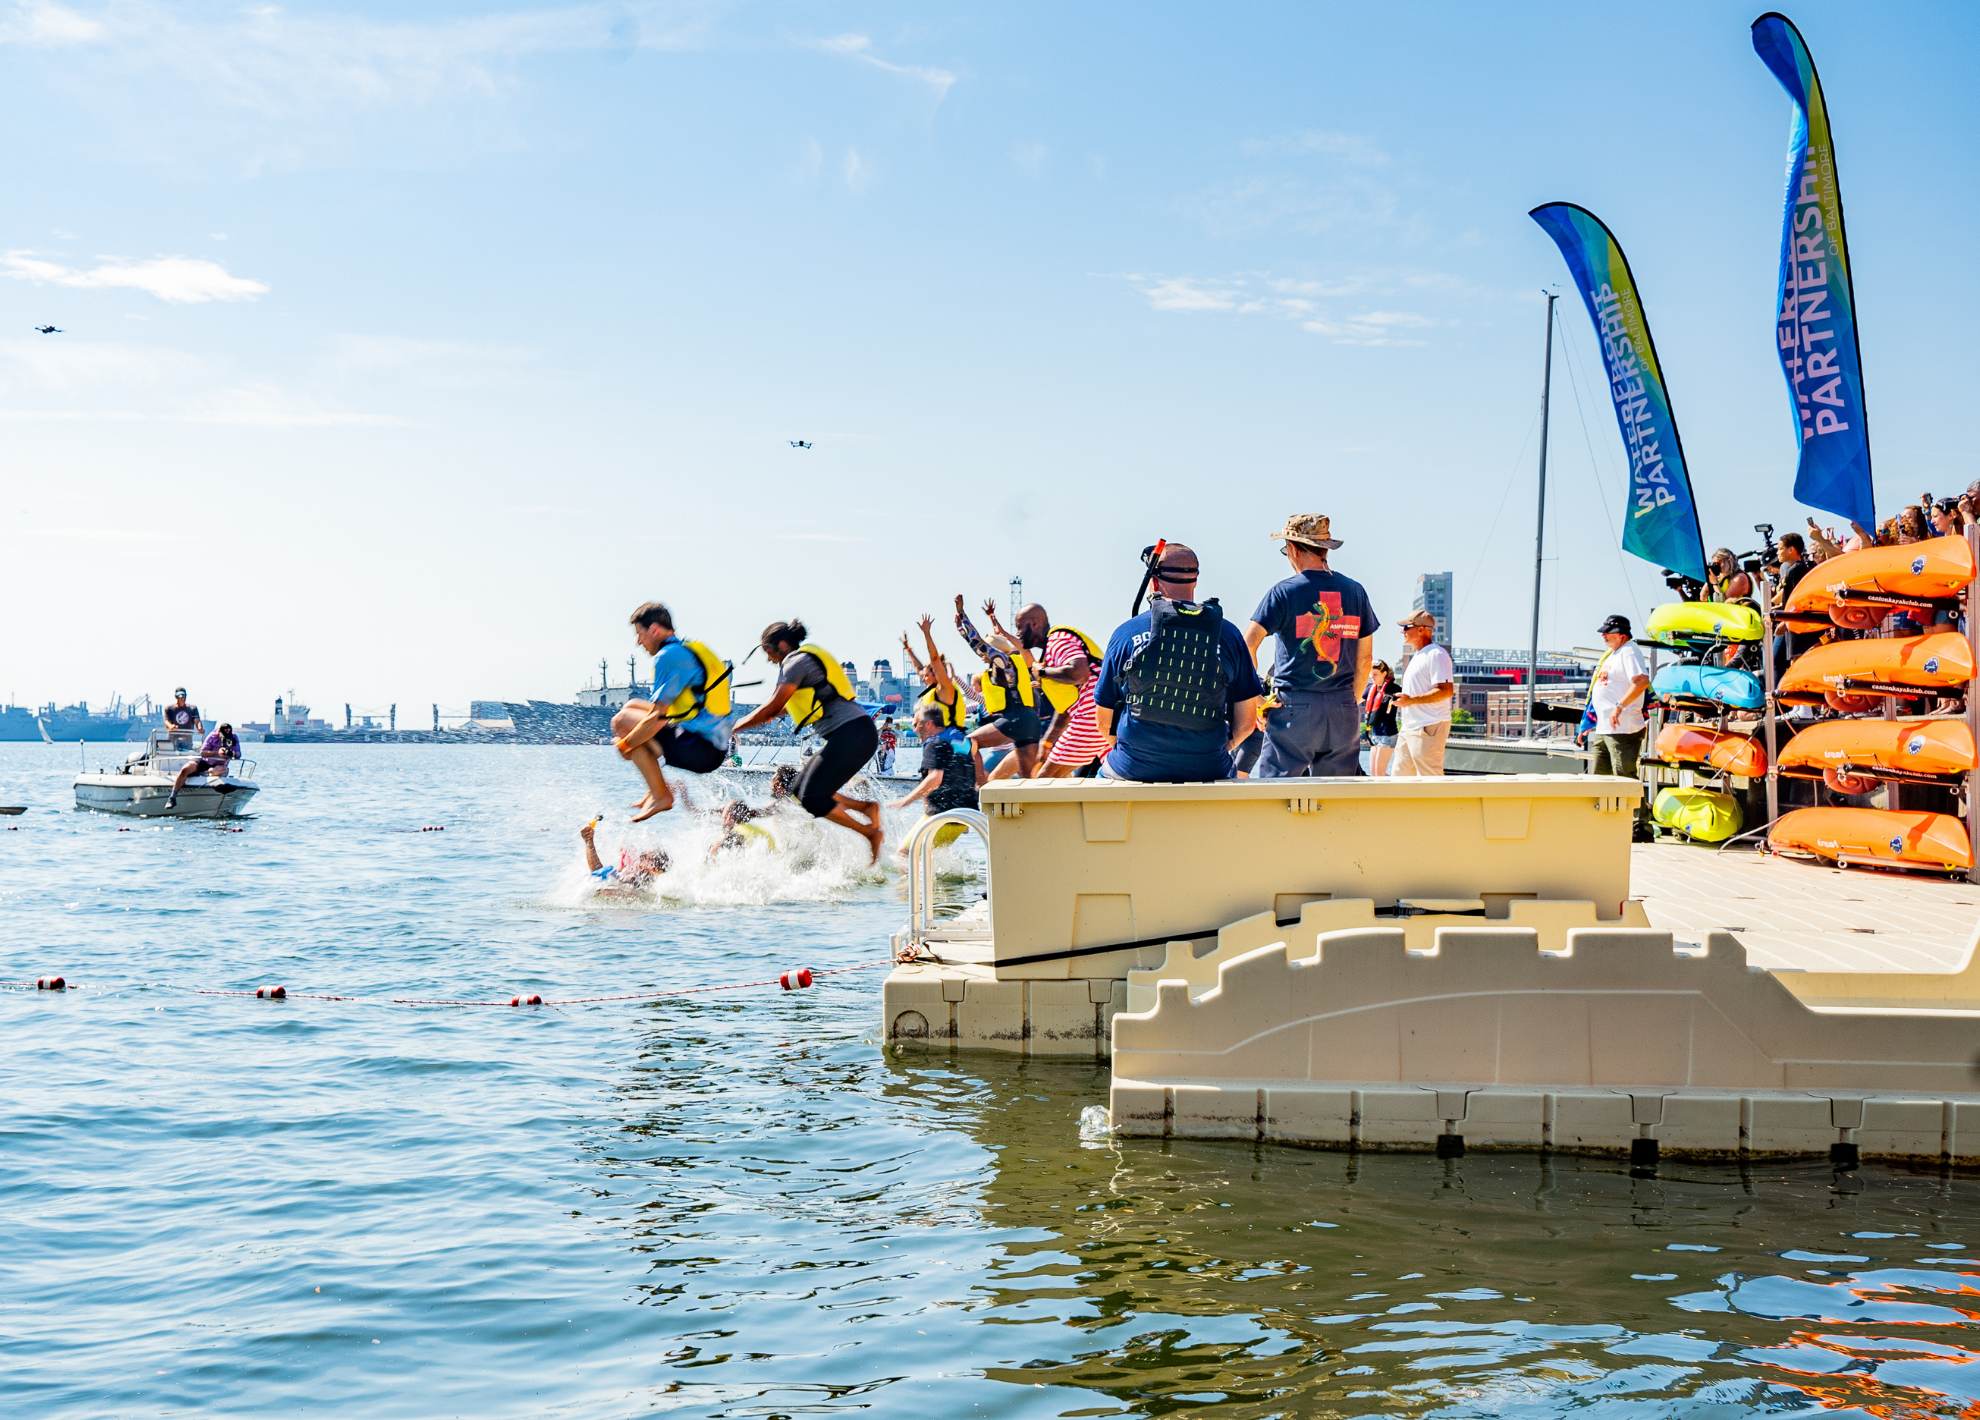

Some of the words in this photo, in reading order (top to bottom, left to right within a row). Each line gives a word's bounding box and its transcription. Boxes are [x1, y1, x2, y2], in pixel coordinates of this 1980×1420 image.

[1818, 143, 1837, 232] BALTIMORE
[1828, 235, 1839, 256] OF
[1620, 287, 1646, 355] BALTIMORE
[1638, 355, 1650, 372] OF
[1601, 282, 1677, 507] PARTNERSHIP
[1867, 594, 1934, 609] cantonkayakclub.com
[1132, 631, 1152, 647] BO
[1452, 647, 1505, 661] UNDER
[1871, 683, 1938, 696] cantonkayakclub.com
